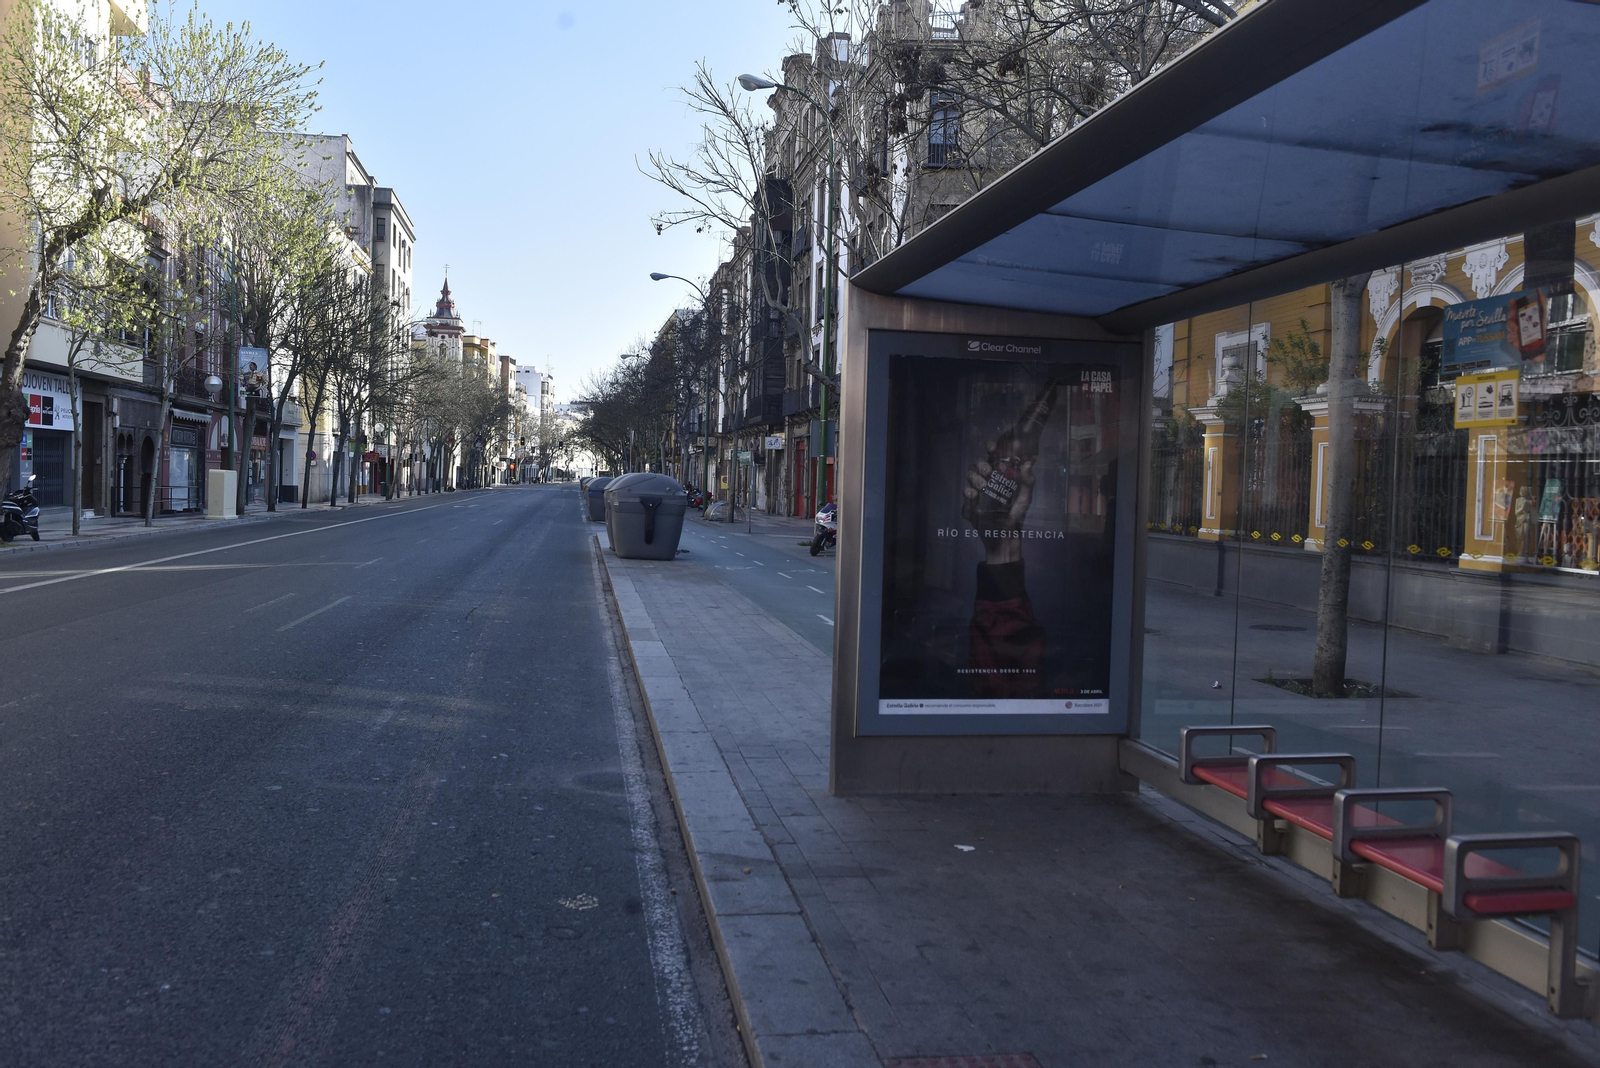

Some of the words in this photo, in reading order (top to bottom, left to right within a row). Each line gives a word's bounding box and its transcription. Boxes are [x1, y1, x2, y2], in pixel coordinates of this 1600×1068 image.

[1476, 306, 1507, 327] Sevilla
[1458, 336, 1472, 346] APP
[981, 342, 1005, 352] Clear
[1005, 344, 1042, 354] Channel
[1081, 370, 1090, 382] LA
[1091, 371, 1112, 382] CASA
[1091, 382, 1113, 393] PAPEL
[990, 470, 1018, 490] Estrella
[988, 479, 1013, 498] Galicia
[938, 528, 958, 537] RÍO
[965, 530, 978, 538] ES
[984, 530, 1064, 539] RESISTENCIA
